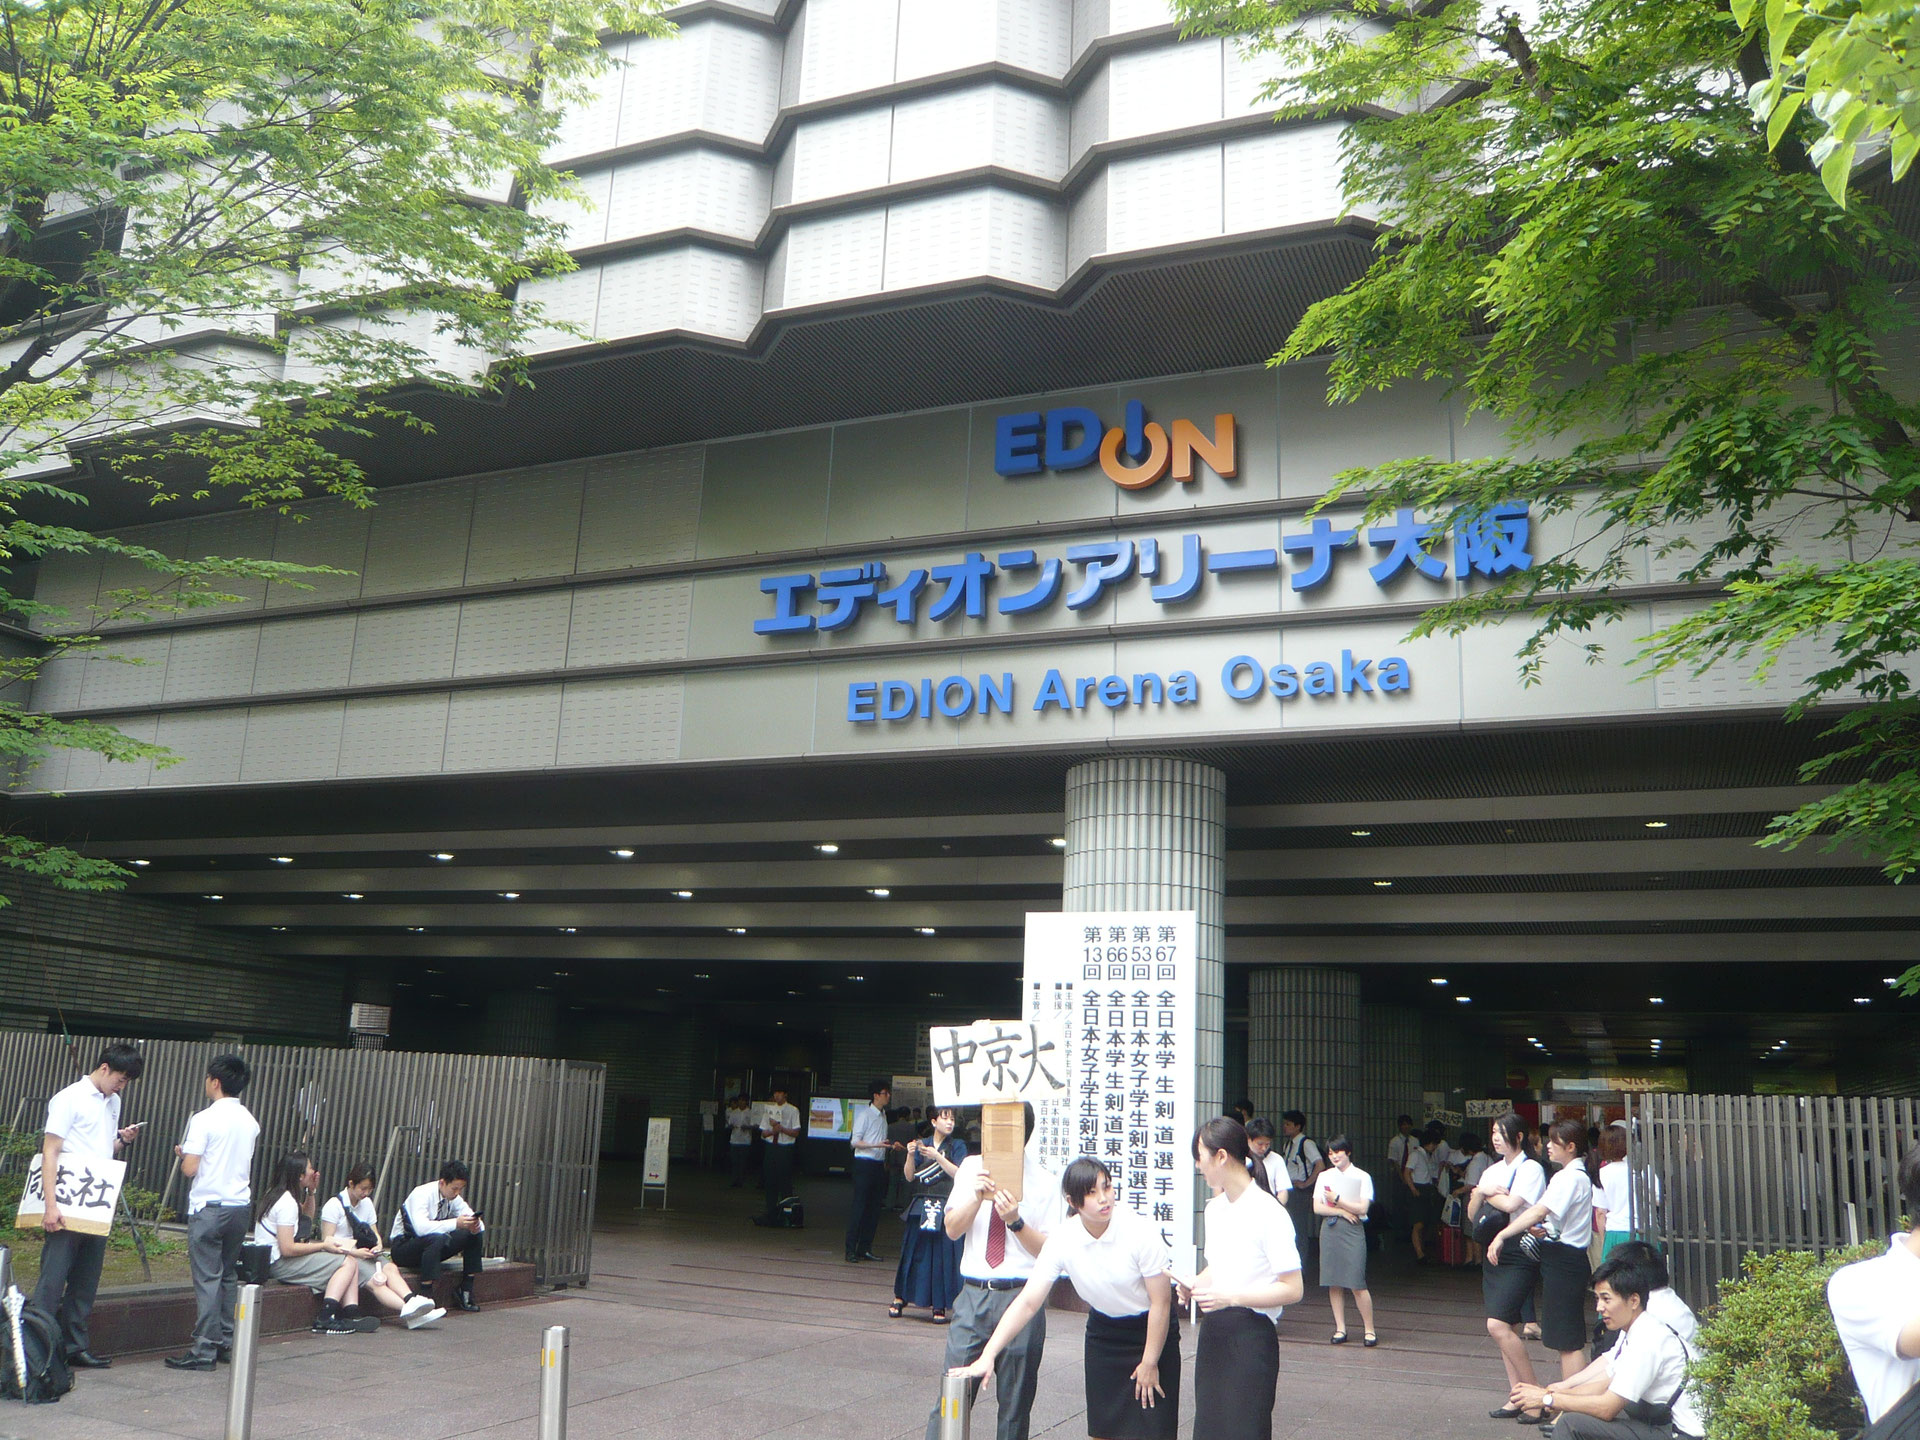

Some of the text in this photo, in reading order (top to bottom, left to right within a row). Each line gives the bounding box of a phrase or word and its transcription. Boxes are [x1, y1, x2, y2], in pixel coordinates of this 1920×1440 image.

[994, 400, 1238, 490] EDION
[753, 499, 1535, 636] エディオンアリーナ大阪
[846, 648, 1411, 723] EDION Arena Osaka
[1082, 925, 1103, 981] 第13回
[1106, 925, 1128, 981] 第66回
[933, 1023, 1065, 1097] 中京大
[1127, 925, 1152, 1217] 第53回 全日本女子学生剣道選手
[1152, 925, 1177, 1270] 第67回 全日本学生剣道選手権大
[22, 1164, 115, 1210] 同志社
